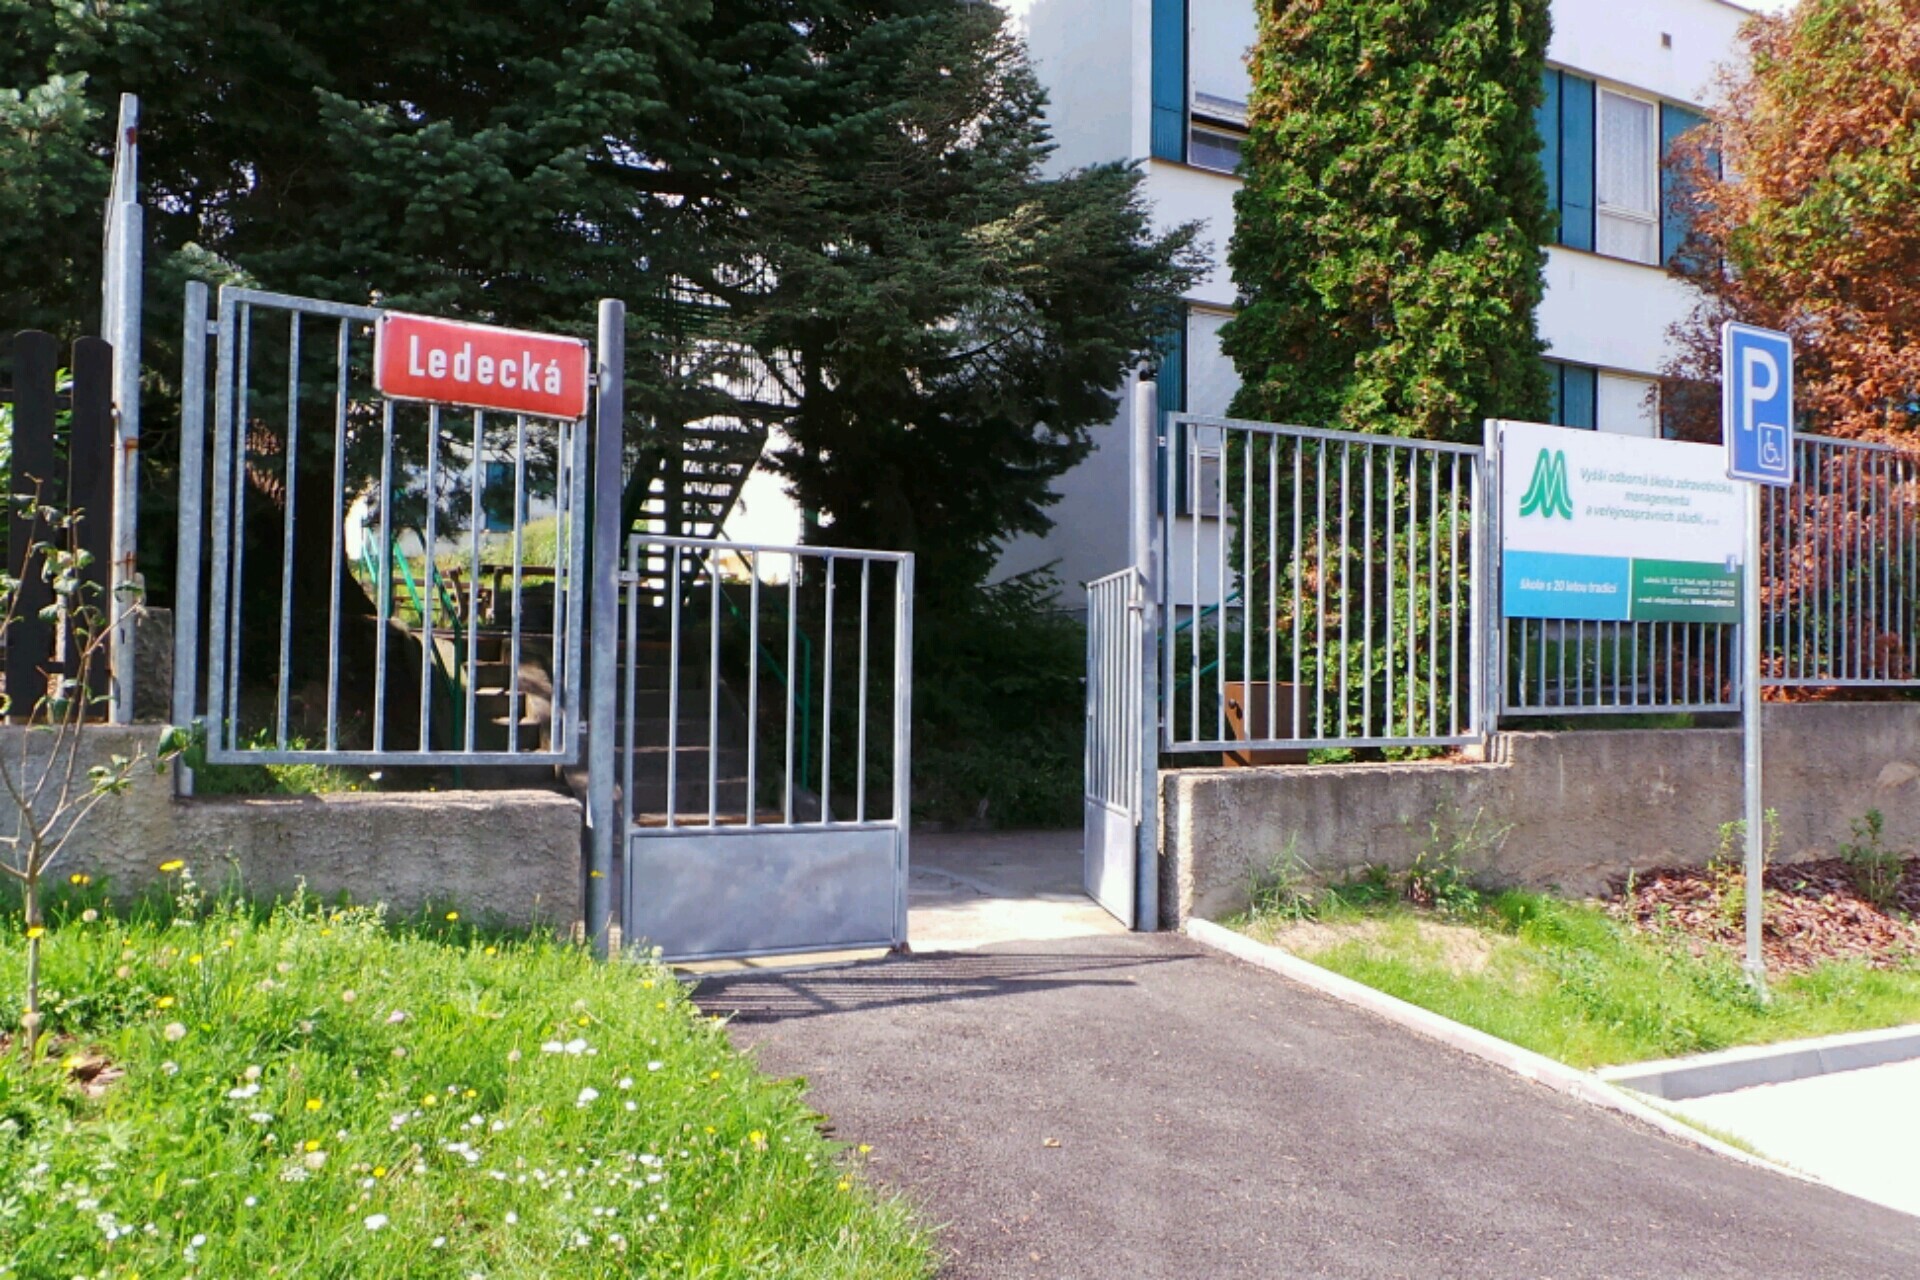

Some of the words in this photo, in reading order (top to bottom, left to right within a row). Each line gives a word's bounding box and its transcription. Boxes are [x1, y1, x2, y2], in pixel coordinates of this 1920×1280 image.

[408, 334, 561, 395] Ledecká
[1743, 346, 1779, 431] P
[1553, 580, 1565, 591] 20
